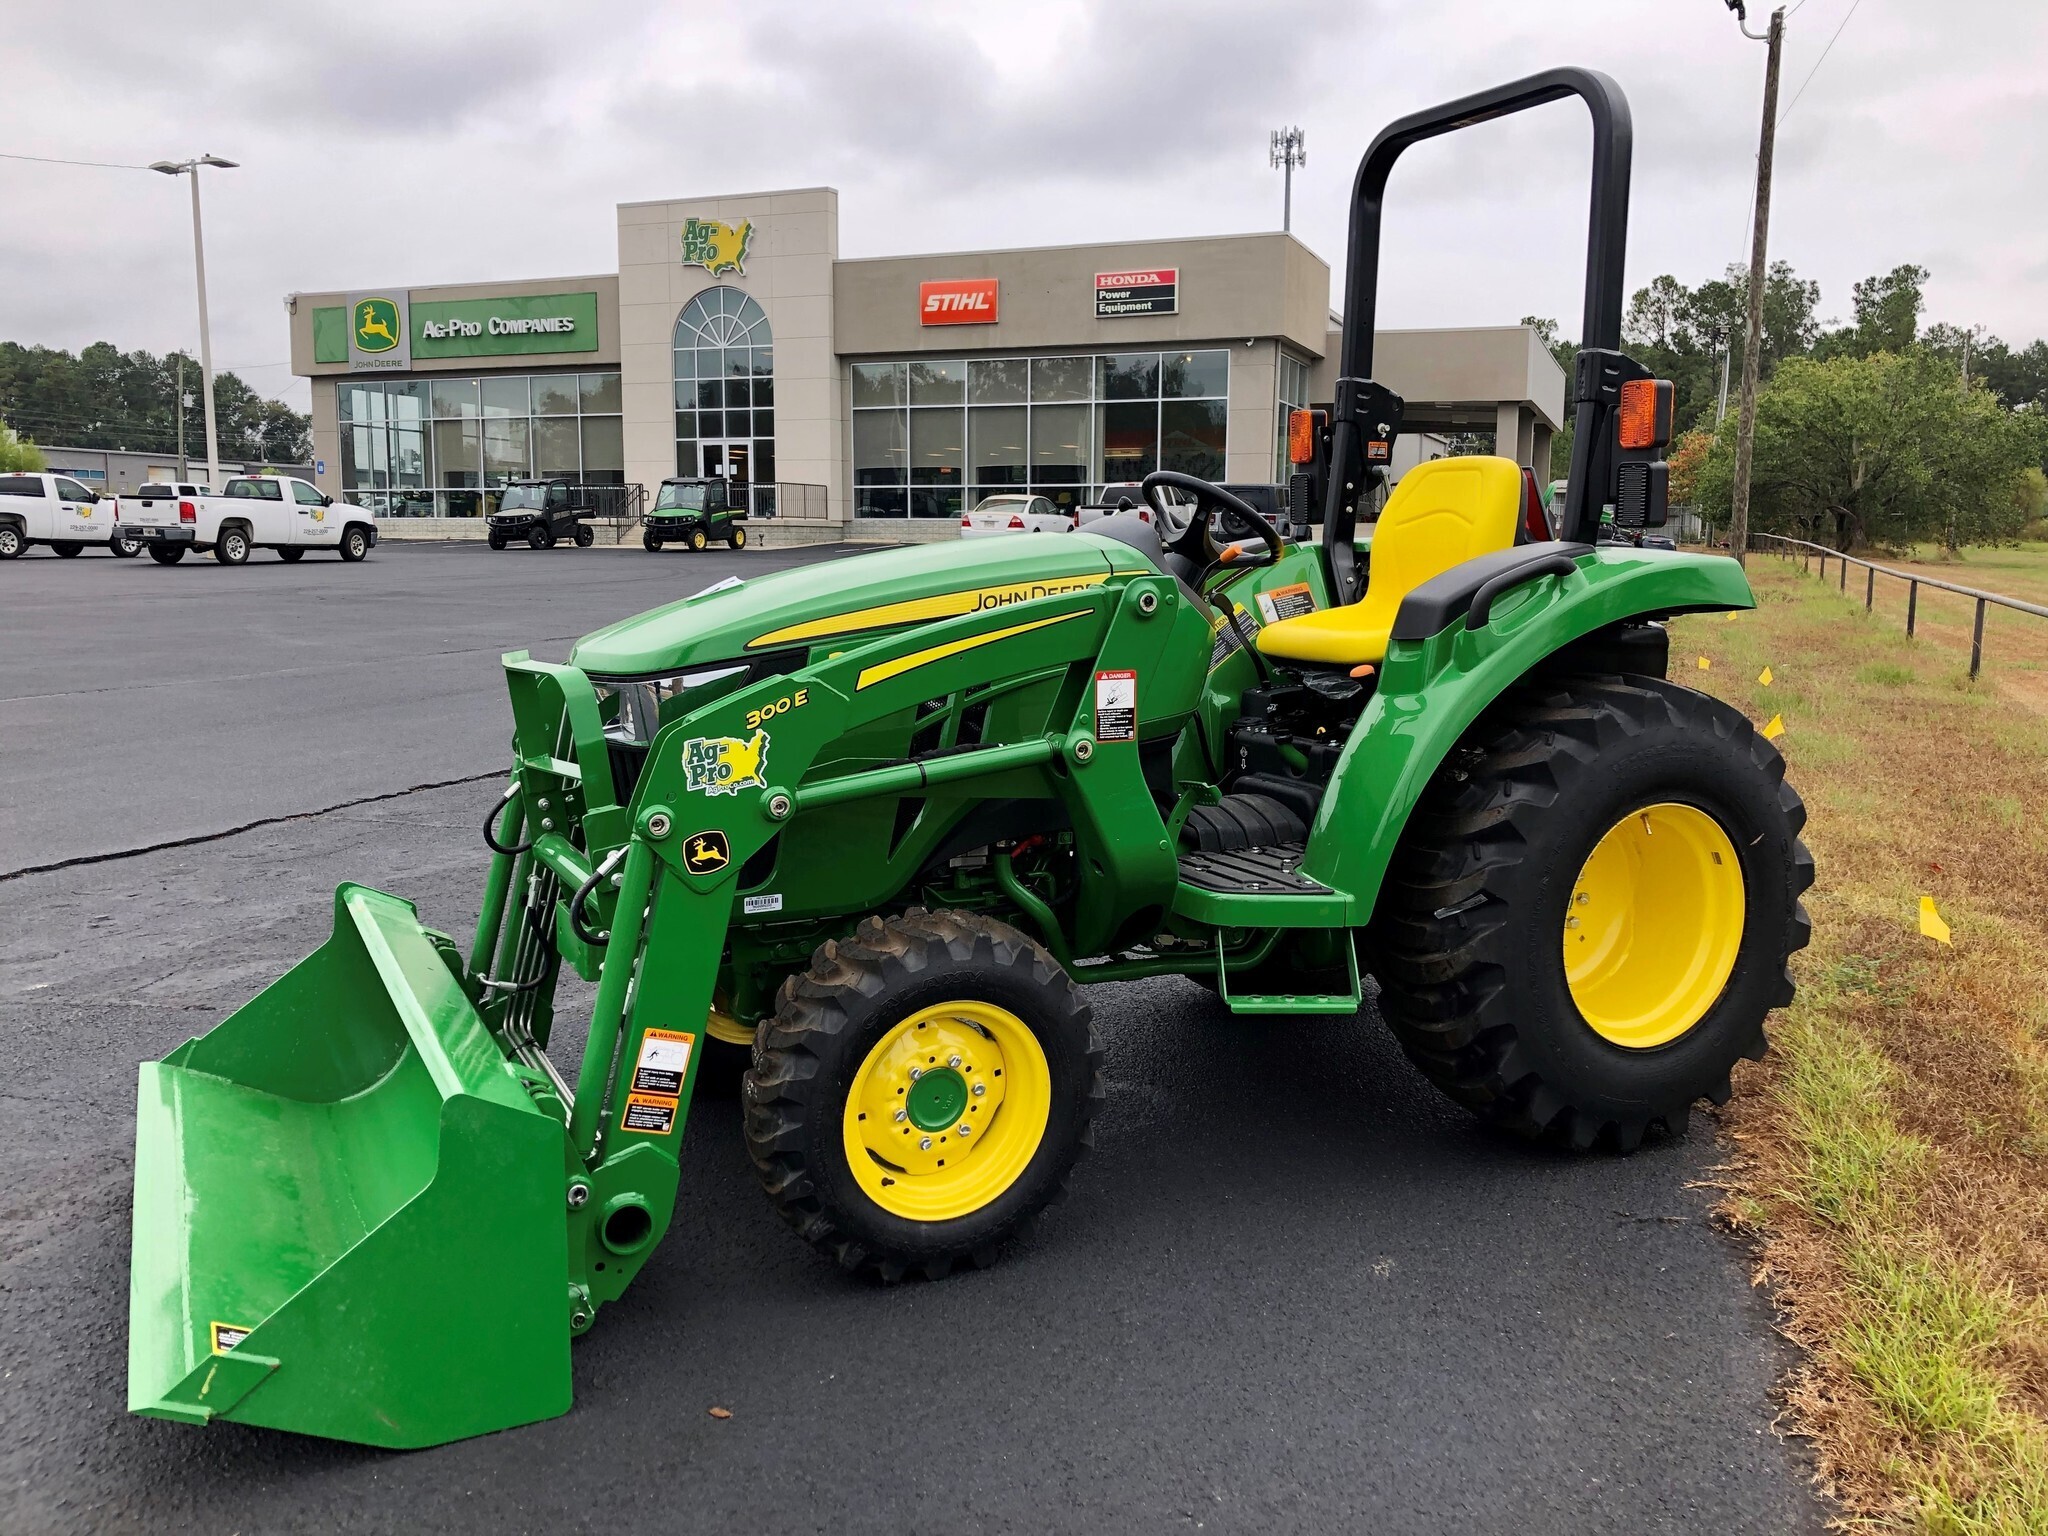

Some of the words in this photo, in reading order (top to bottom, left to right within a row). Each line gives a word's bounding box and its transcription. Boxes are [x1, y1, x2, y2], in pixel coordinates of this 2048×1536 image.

[683, 219, 718, 245] Ag-
[683, 241, 719, 263] Pro
[1099, 273, 1161, 285] HONDA
[924, 292, 990, 312] STIHL
[1099, 289, 1131, 300] Power
[1099, 302, 1152, 314] Equipment
[354, 360, 374, 369] JOHN
[374, 359, 403, 368] DEERE
[971, 591, 1027, 613] JOHN
[1032, 584, 1091, 600] DEER
[746, 696, 792, 730] 300
[794, 688, 809, 707] E
[687, 741, 729, 766] Ag-
[688, 763, 733, 787] Pro
[862, 970, 984, 1030] GALAXY
[657, 1032, 689, 1042] WARNING
[641, 1098, 673, 1107] WARNING
